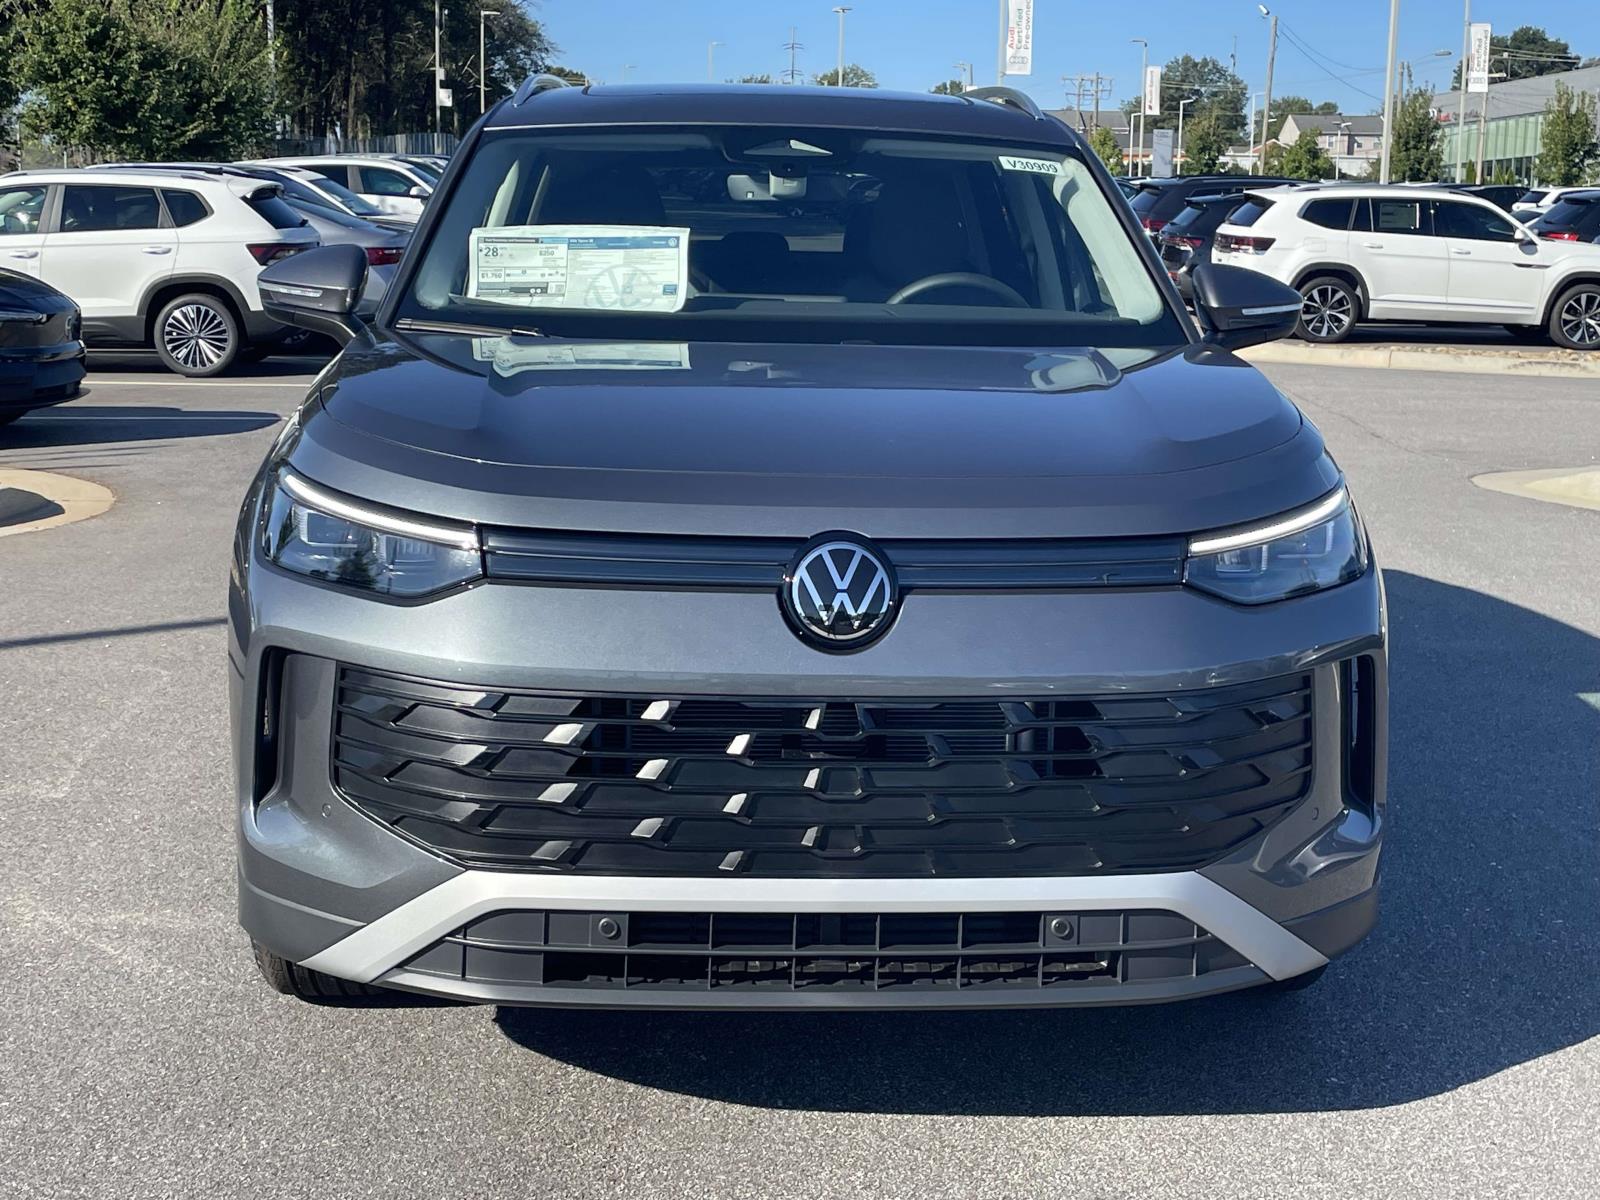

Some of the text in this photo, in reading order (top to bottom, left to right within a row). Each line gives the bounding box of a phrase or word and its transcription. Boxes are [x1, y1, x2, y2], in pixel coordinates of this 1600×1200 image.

[1015, 8, 1024, 50] Certified
[1006, 158, 1058, 173] V30909
[484, 246, 499, 257] 28
